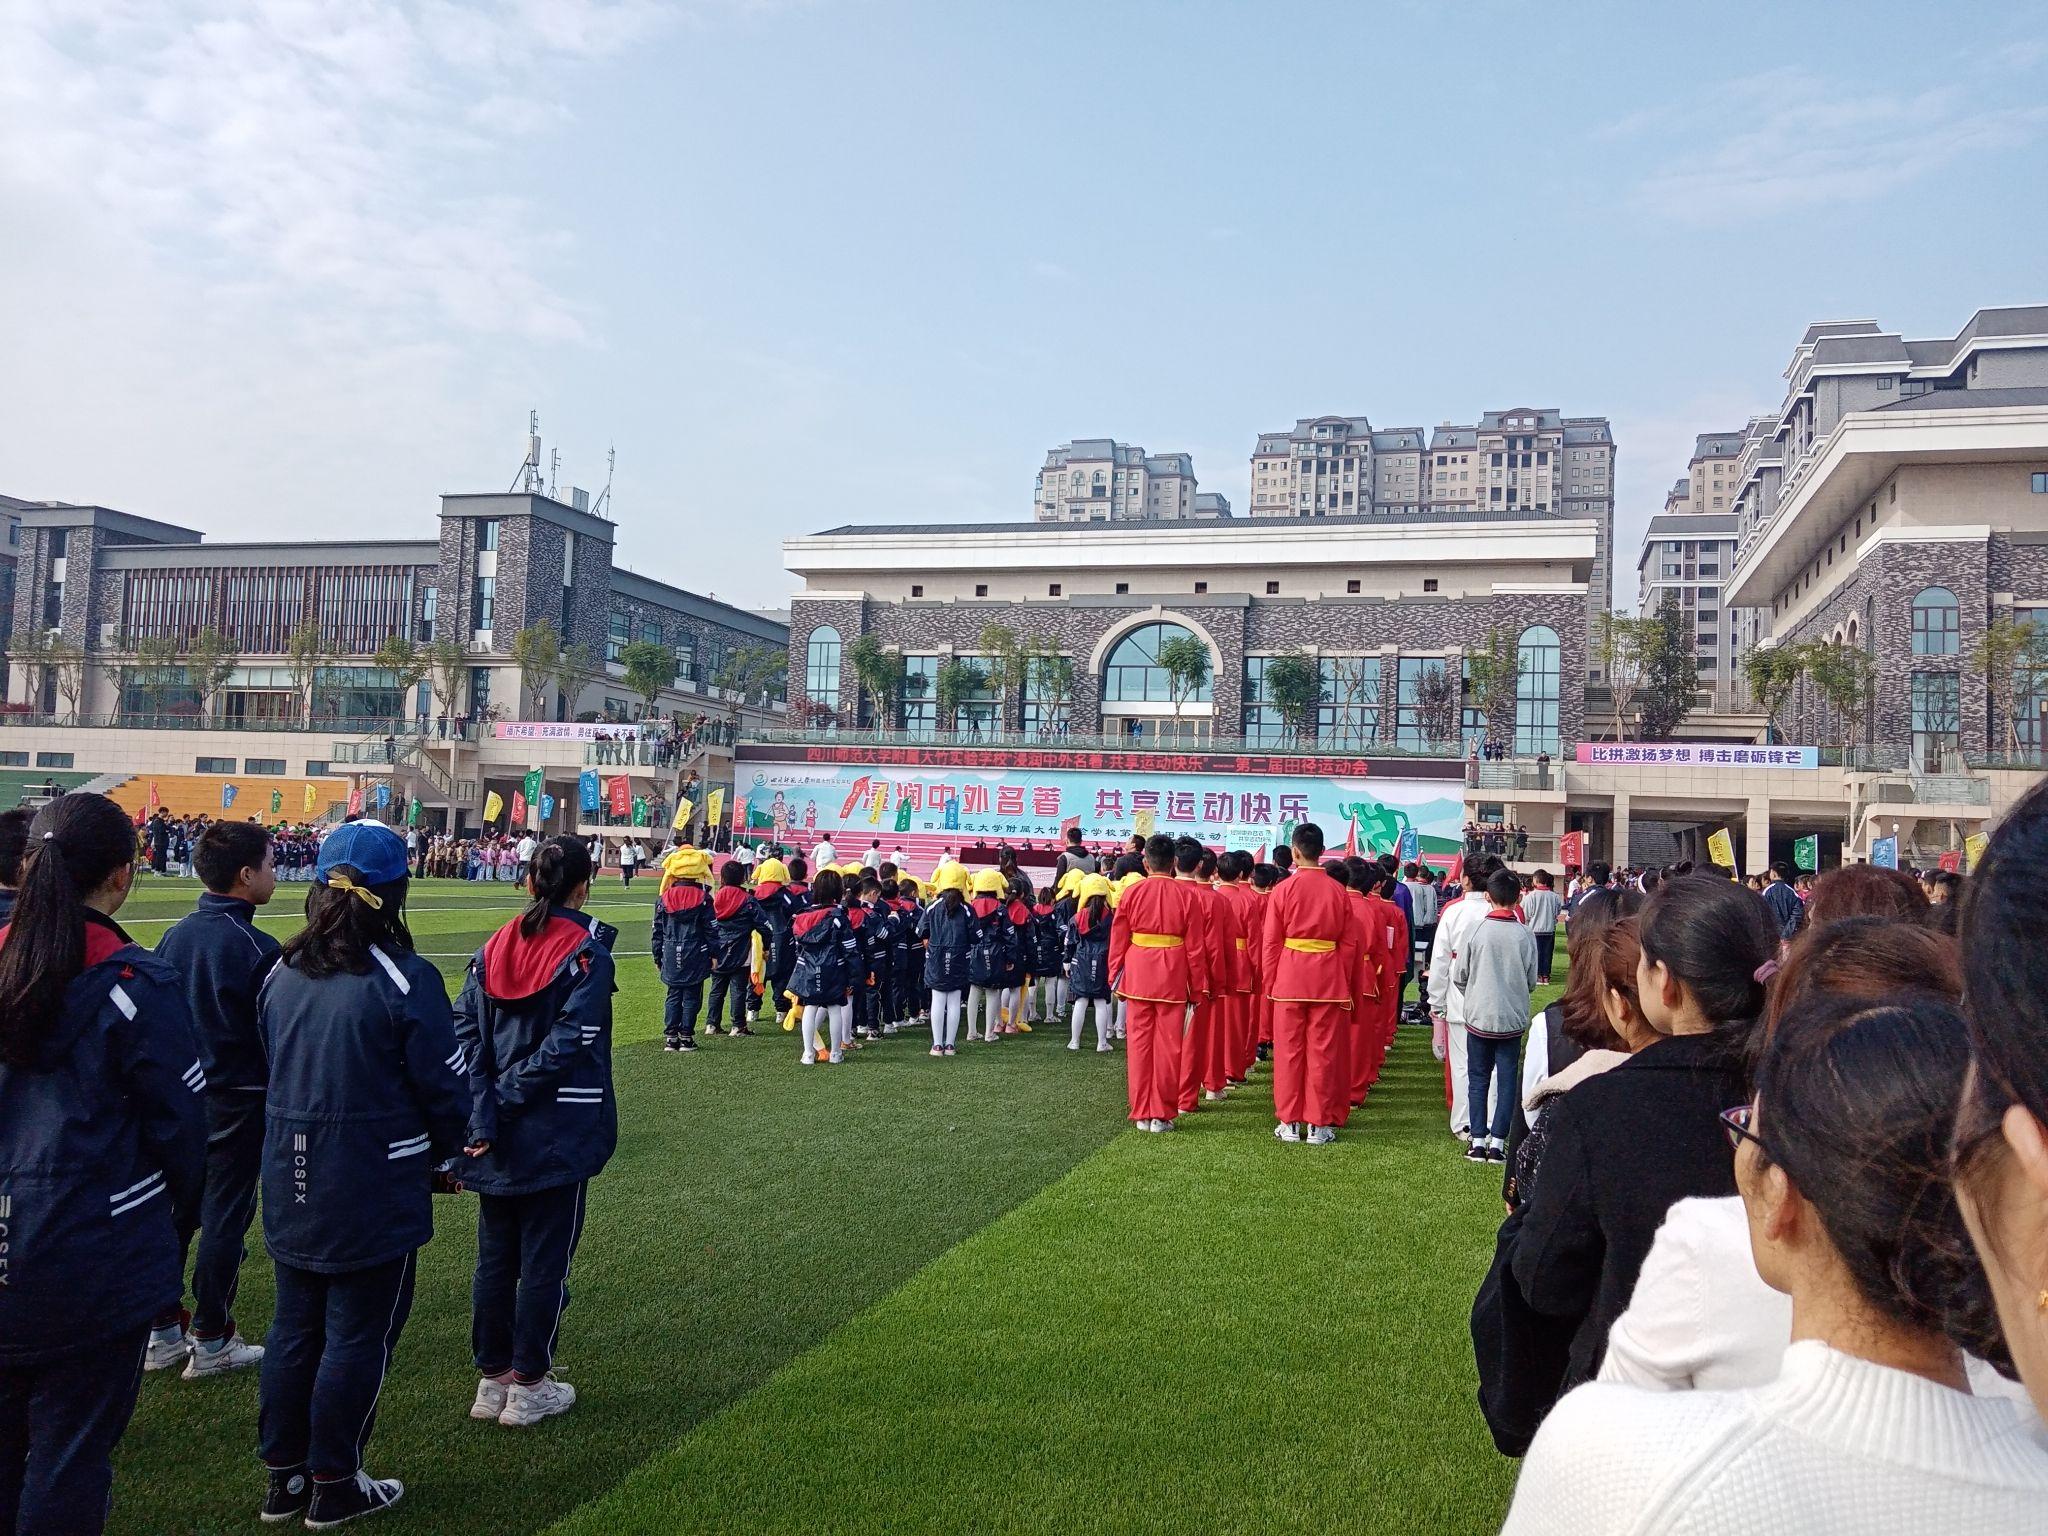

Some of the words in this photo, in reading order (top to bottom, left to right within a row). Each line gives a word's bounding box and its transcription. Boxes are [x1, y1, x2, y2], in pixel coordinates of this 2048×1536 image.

[1591, 747, 1691, 762] 比拼激扬梦想
[1698, 748, 1802, 764] 搏击磨砺锋芒
[1094, 788, 1309, 823] 共享运动快乐
[294, 1155, 307, 1204] CSFX
